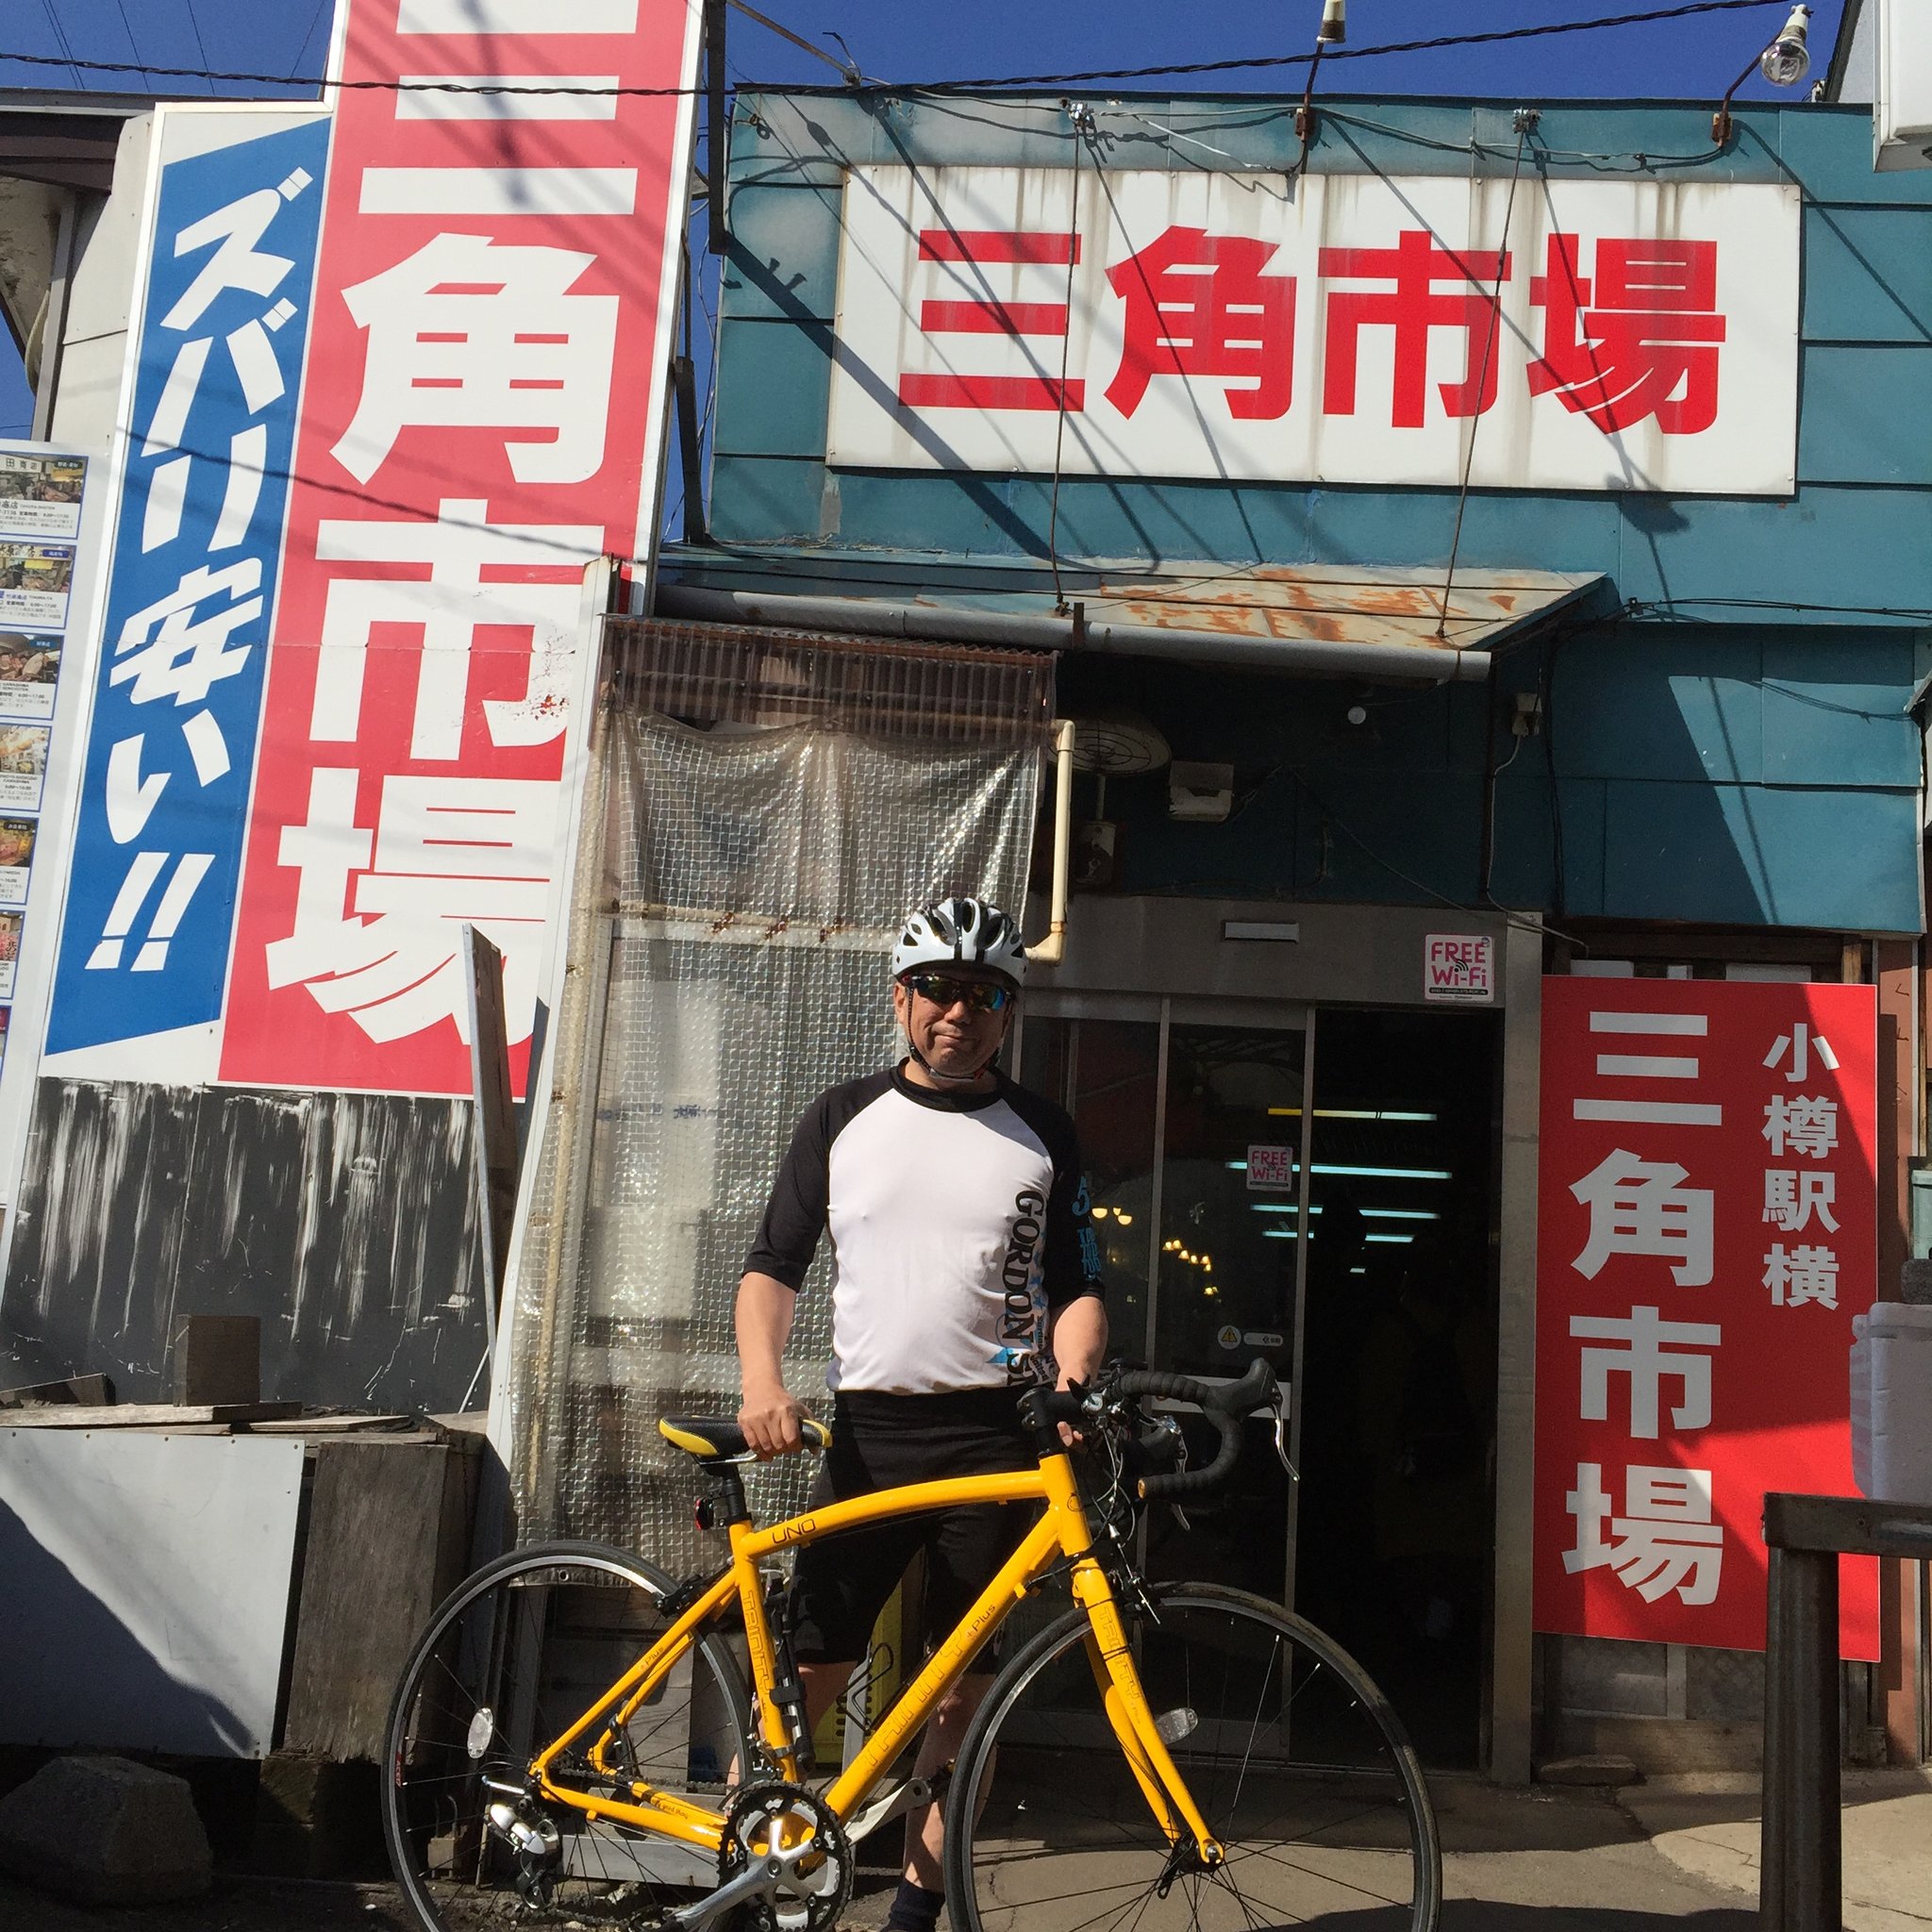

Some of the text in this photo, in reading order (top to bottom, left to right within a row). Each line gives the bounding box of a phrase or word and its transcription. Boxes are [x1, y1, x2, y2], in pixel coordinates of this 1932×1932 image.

[899, 225, 1727, 435] 三角市場
[266, 0, 639, 1047] 三角市場
[1430, 965, 1487, 988] Wi-Fi
[1431, 941, 1486, 964] FREE
[1251, 1166, 1288, 1182] Wi-Fi
[1252, 1150, 1288, 1166] FREE
[1761, 1023, 1841, 1311] 小樽駅横
[1001, 1190, 1046, 1343] GORDON
[1562, 1011, 1724, 1607] 三角市場
[773, 1518, 816, 1544] UNO
[743, 1590, 771, 1695] TRINITY
